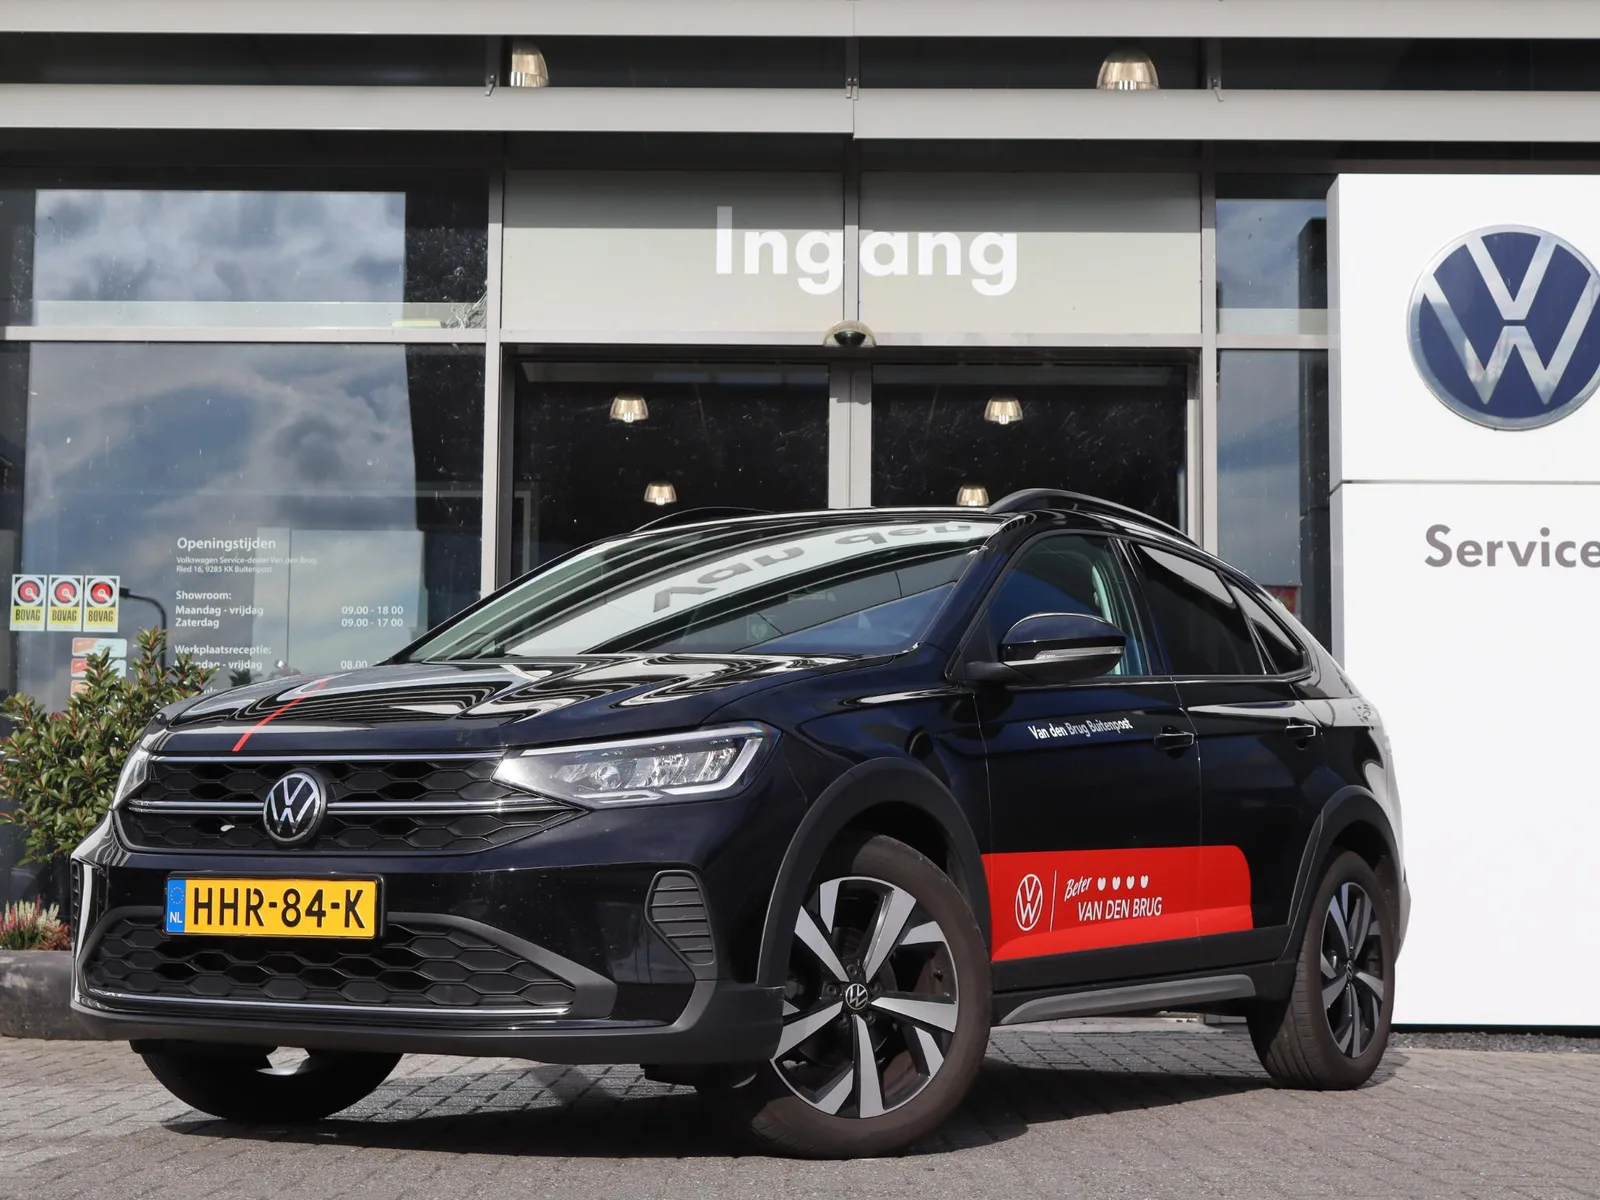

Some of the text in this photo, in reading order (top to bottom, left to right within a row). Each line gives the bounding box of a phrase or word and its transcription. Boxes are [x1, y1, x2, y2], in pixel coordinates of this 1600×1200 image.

[716, 206, 1018, 296] Ingang
[177, 537, 276, 551] Openingstijden
[1425, 524, 1600, 568] Service
[176, 556, 218, 564] Volkswagen
[194, 566, 204, 574] 16,
[235, 565, 272, 574] Buitenpost
[176, 591, 232, 600] Showroom:
[15, 609, 41, 621] BOVAG
[52, 609, 77, 621] BOVAG
[88, 610, 114, 622] BOVAG
[175, 605, 221, 616] Maandag
[229, 605, 264, 617] vrijdag
[341, 606, 369, 615] 09.00
[175, 617, 220, 629] Zaterdag
[341, 618, 369, 627] 09.00
[174, 645, 272, 655] Werkplaatsreceptie:
[228, 660, 263, 670] vrijdag
[340, 660, 368, 669] 08.00
[1028, 718, 1134, 740] Van den Brug Buitenpost
[1063, 876, 1093, 902] Beter
[193, 887, 366, 929] HHR-84-K
[1078, 896, 1163, 922] VAN DEN BRUG
[169, 911, 183, 924] NL
